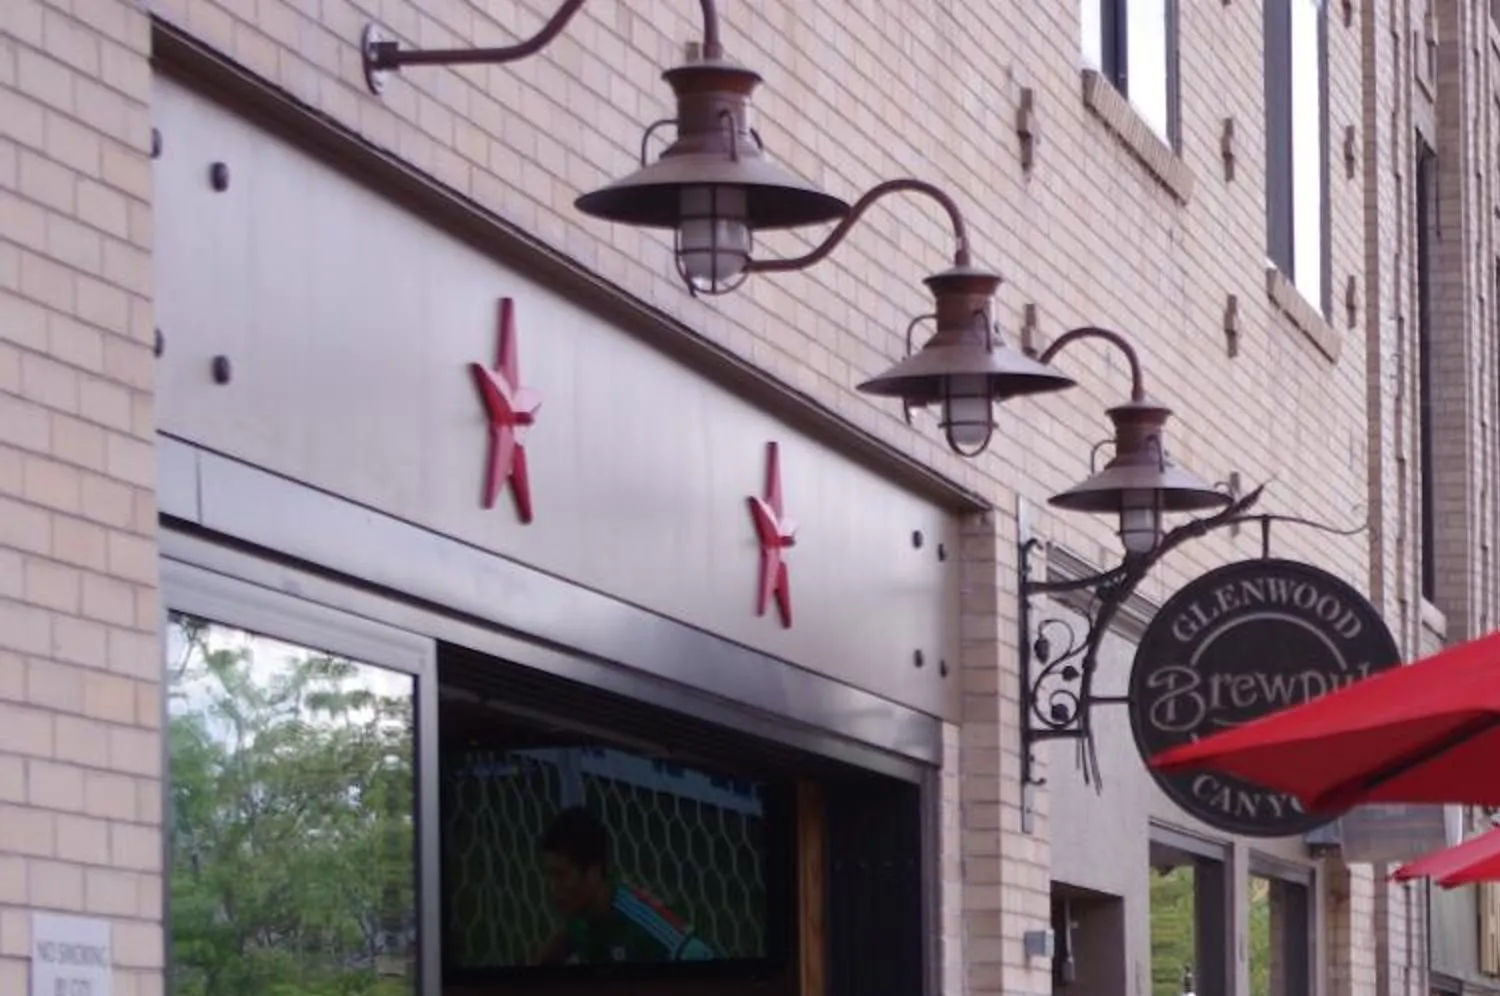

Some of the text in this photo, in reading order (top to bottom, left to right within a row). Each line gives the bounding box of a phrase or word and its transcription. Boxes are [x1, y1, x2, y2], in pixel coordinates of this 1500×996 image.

[1172, 577, 1363, 642] GLENWOOD
[1148, 661, 1371, 733] Brewp
[1192, 773, 1307, 818] CANY
